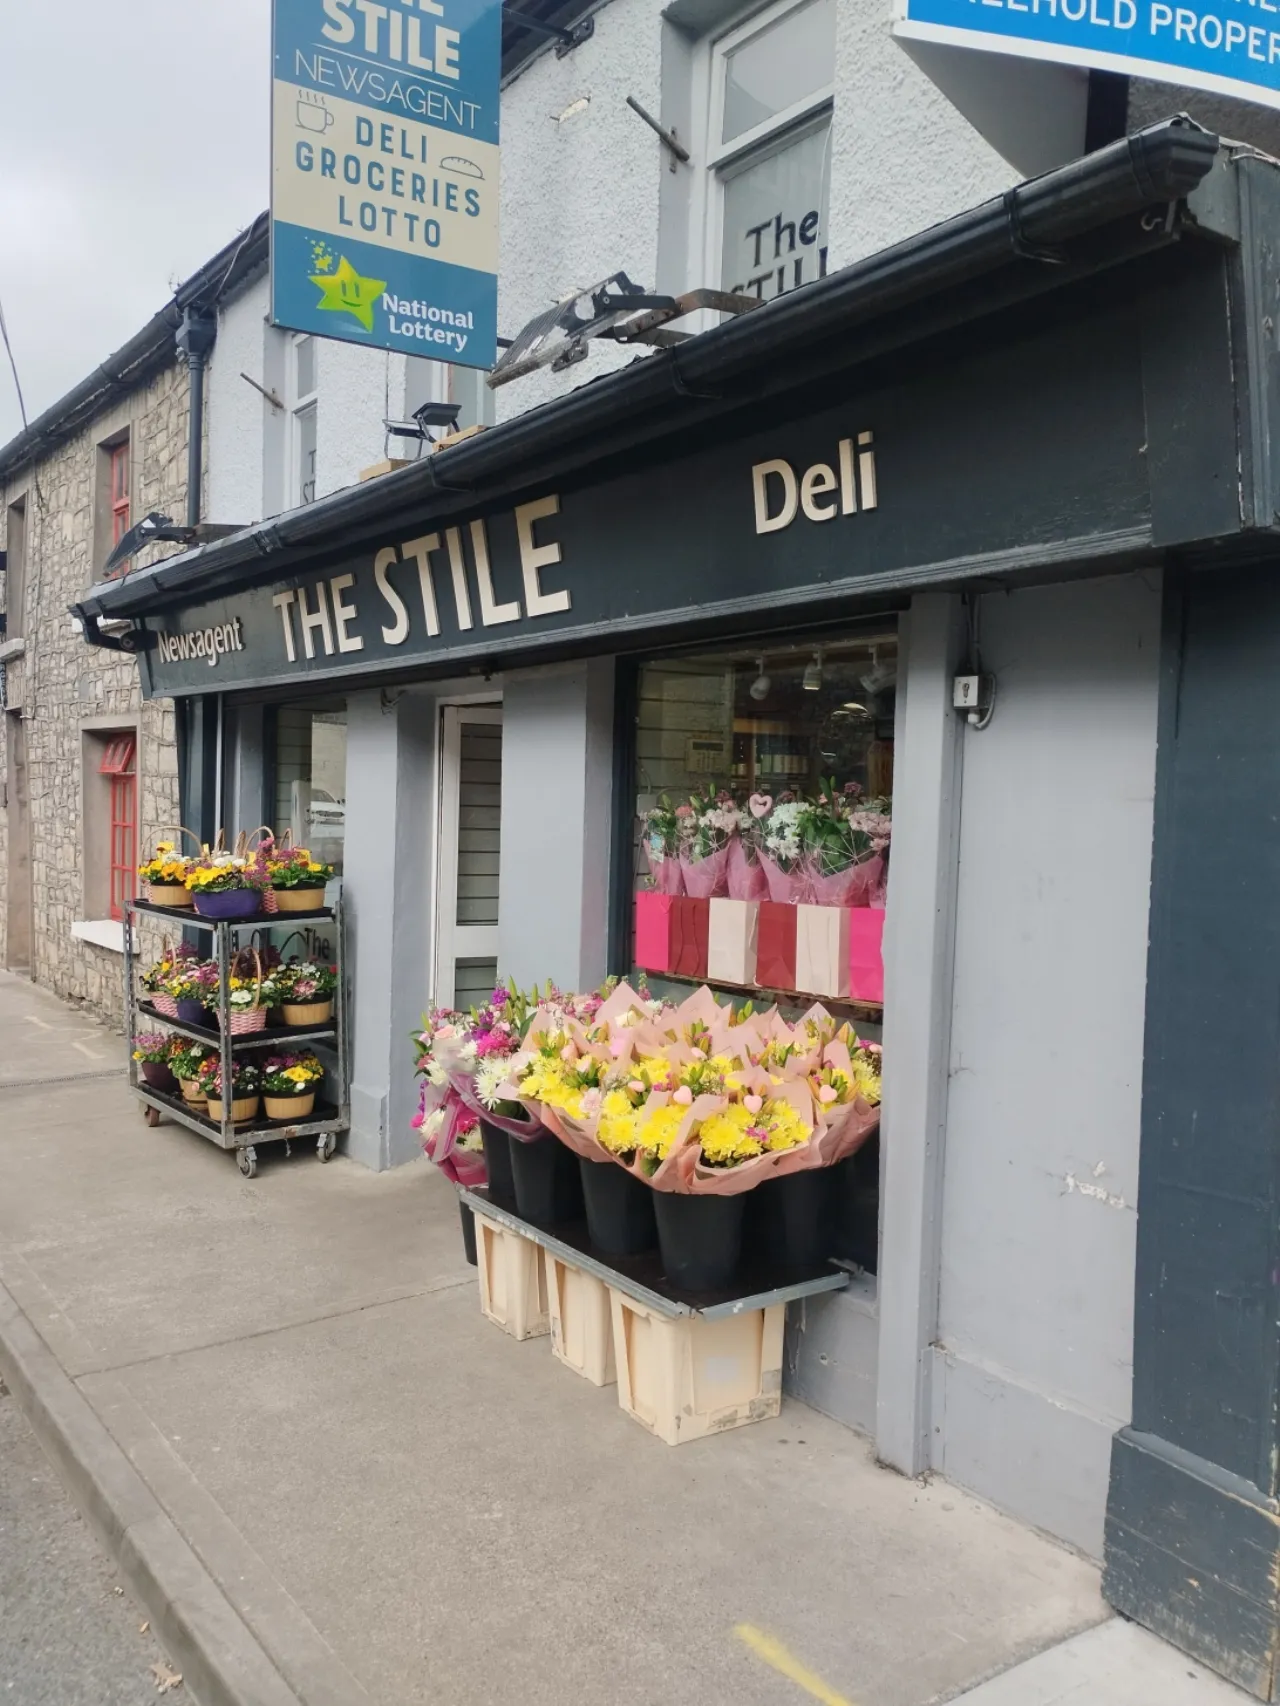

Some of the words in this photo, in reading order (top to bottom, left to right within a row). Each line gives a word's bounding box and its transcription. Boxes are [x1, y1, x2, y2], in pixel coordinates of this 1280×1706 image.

[320, 0, 460, 80] STILE
[295, 49, 481, 129] NEWSAGENT
[355, 115, 427, 163] DELI
[295, 141, 481, 217] GROCERIES
[338, 195, 441, 248] LOTTO
[744, 210, 819, 268] The
[381, 292, 474, 330] National
[388, 315, 468, 353] Lottery
[752, 430, 877, 534] Deli
[273, 573, 364, 662] THE
[374, 494, 571, 645] STILE
[157, 616, 243, 666] Newsagent
